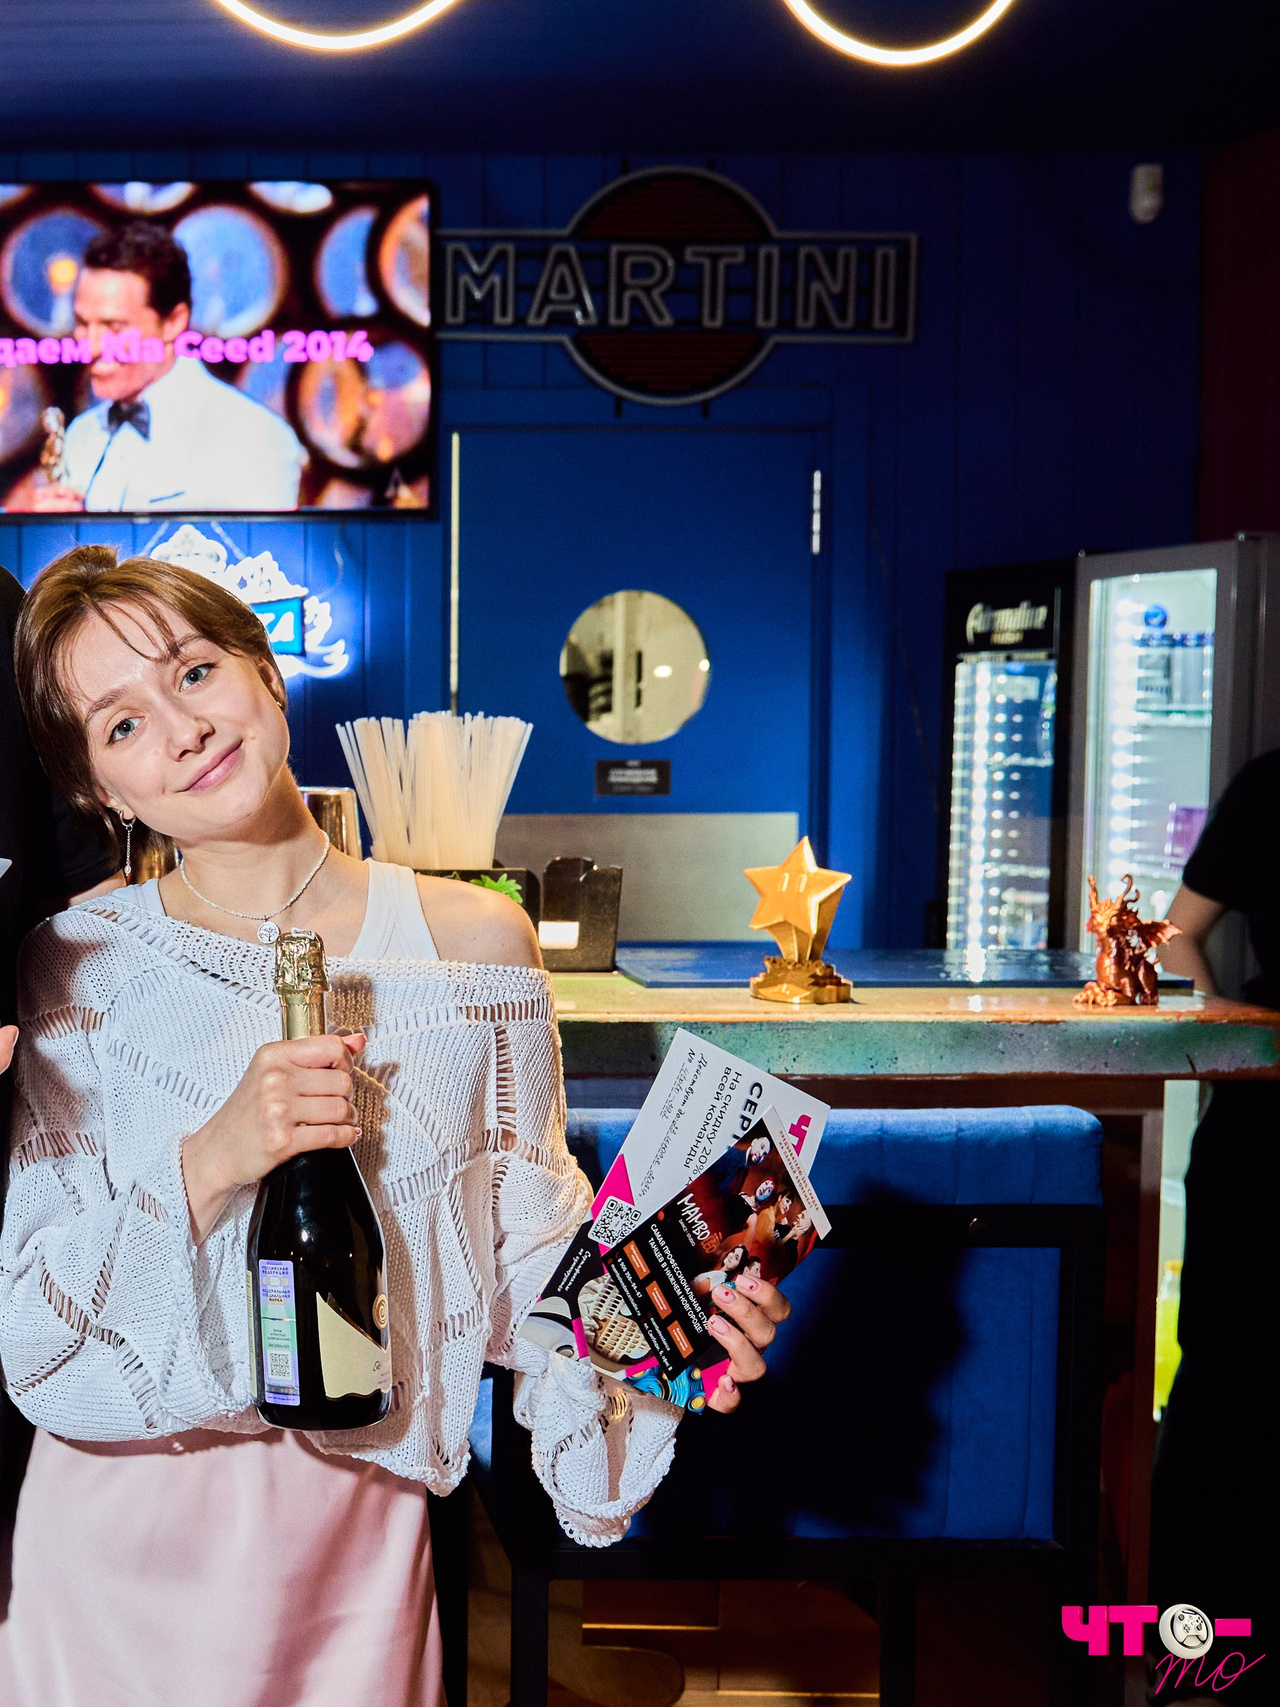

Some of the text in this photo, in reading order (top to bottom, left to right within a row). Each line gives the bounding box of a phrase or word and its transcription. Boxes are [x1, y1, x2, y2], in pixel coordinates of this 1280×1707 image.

[445, 242, 896, 329] MARTINI
[102, 329, 165, 364] Kia
[174, 329, 276, 364] Ceed
[282, 329, 375, 364] 2014
[681, 1052, 707, 1106] Действует
[713, 1066, 731, 1101] всей
[683, 1103, 716, 1168] команды
[692, 1071, 742, 1178] На скидку 20%
[675, 1192, 712, 1241] MAMBO
[648, 1237, 664, 1262] ТАНЦЕВ
[663, 1266, 682, 1295] НИЖНЕМ
[679, 1294, 703, 1333] НОВГОРОДЕ!
[650, 1223, 665, 1246] САМАЯ
[662, 1245, 701, 1312] ПРОФЕССИОНАЛЬНАЯ
[696, 1310, 712, 1337] СТУД
